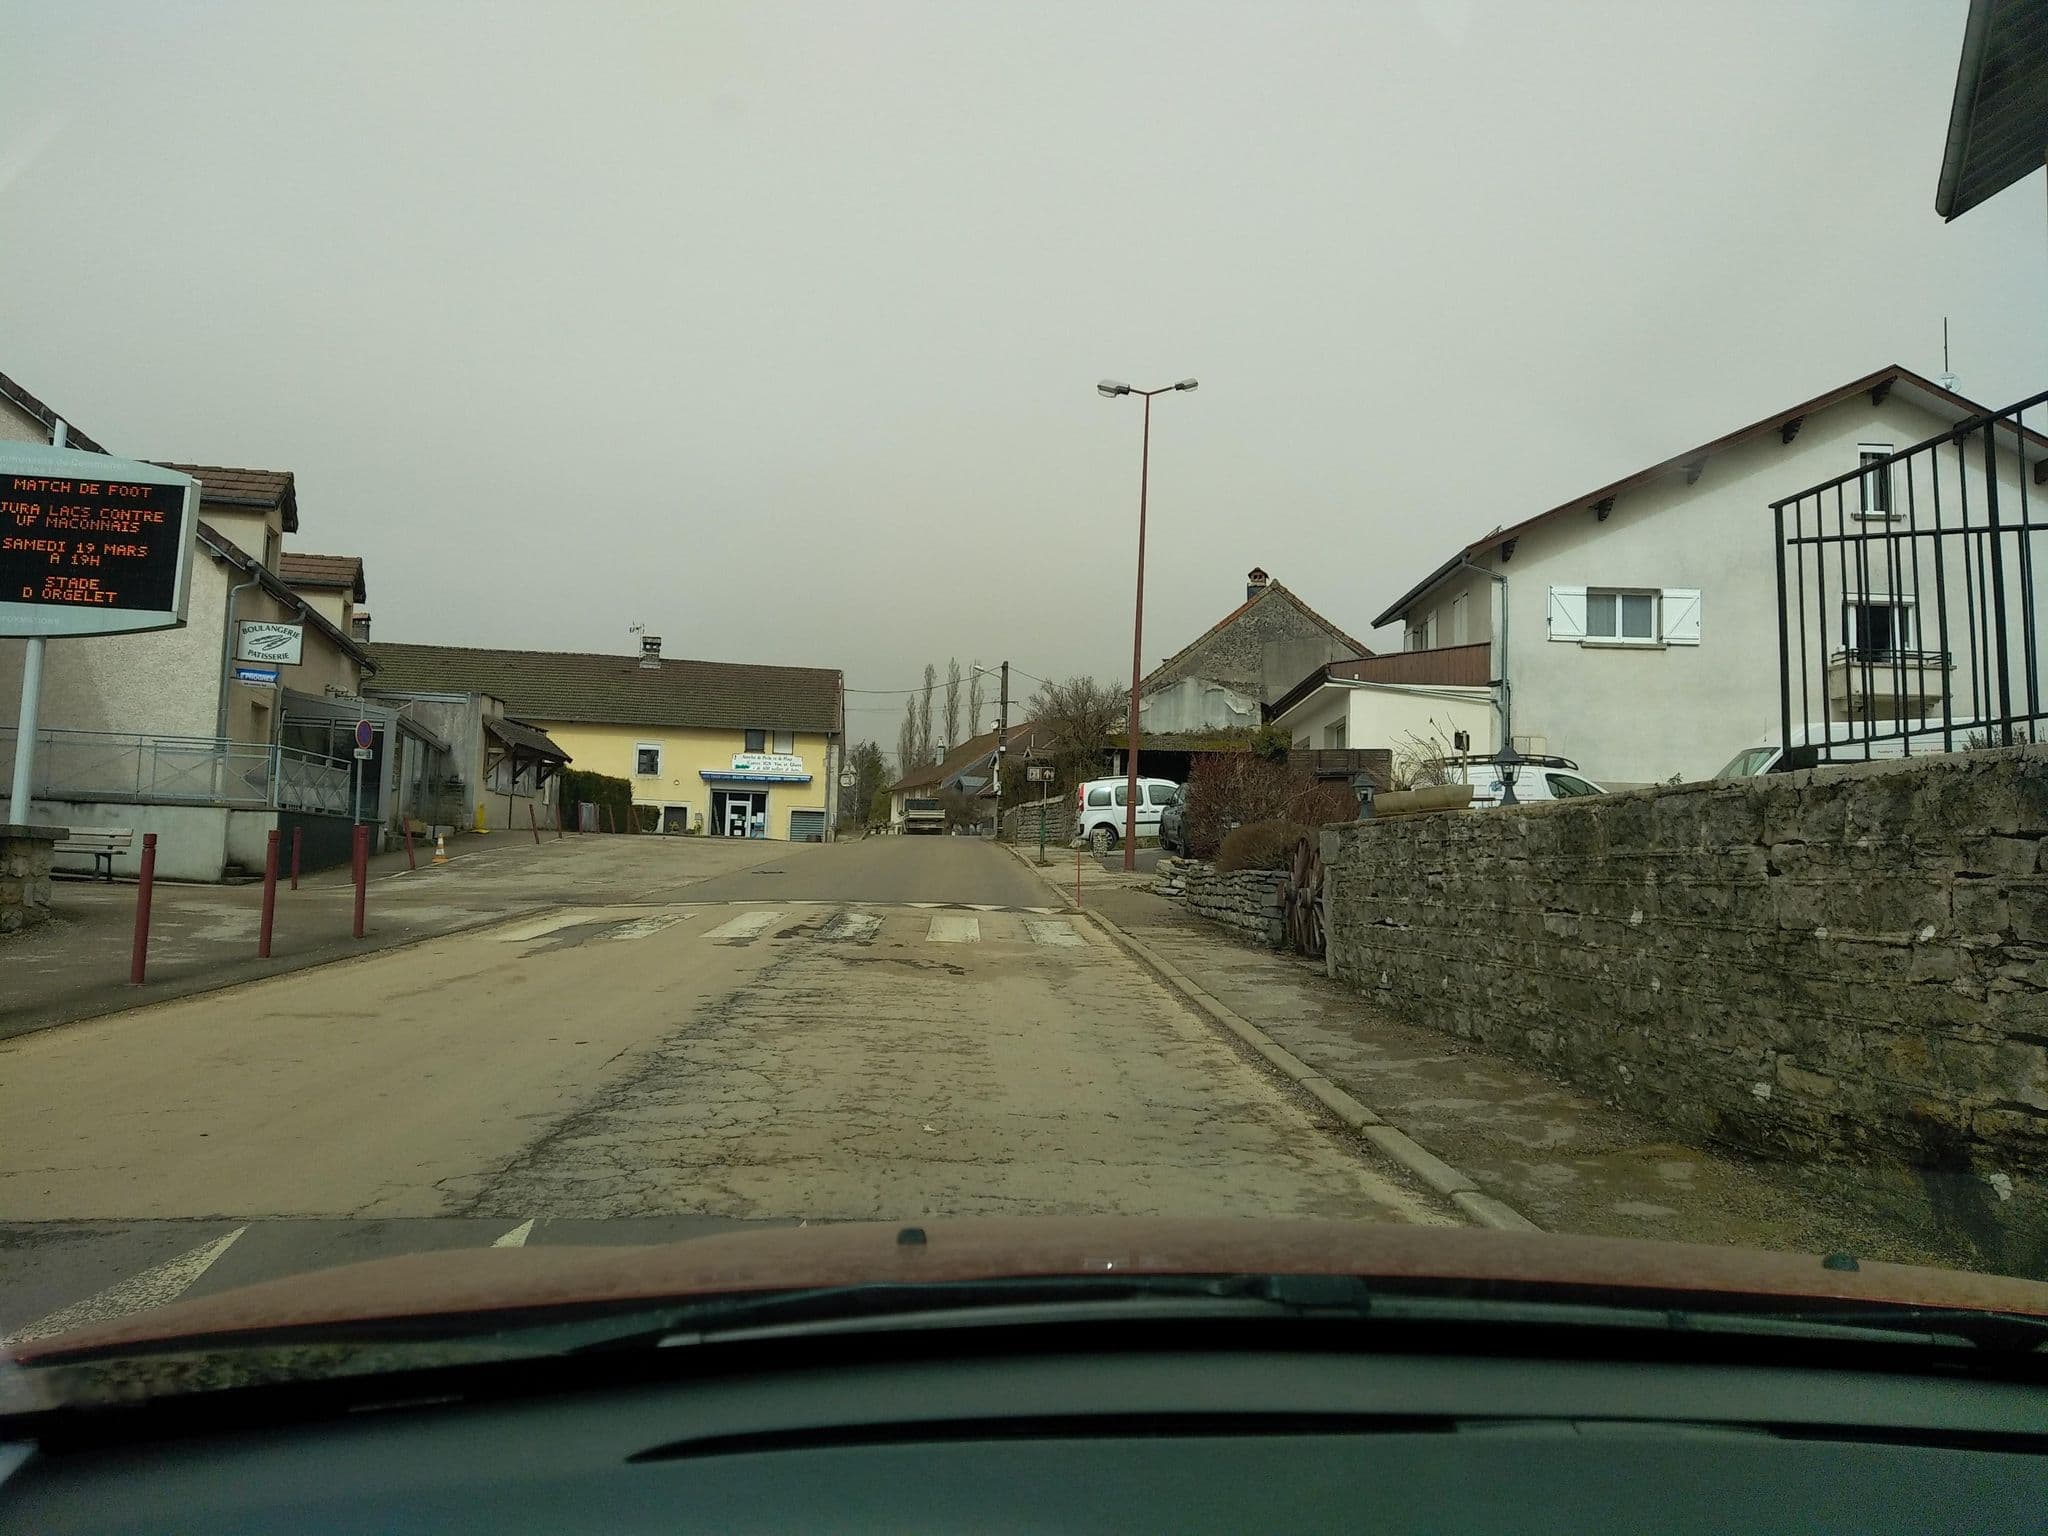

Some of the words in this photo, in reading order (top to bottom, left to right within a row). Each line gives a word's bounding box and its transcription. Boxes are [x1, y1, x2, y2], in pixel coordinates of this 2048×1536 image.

[14, 479, 71, 493] MATCH
[79, 483, 100, 495] DE
[108, 486, 152, 497] FOOT
[0, 501, 41, 515] JURA
[49, 505, 91, 518] LACS
[99, 510, 165, 523] CONTRE
[16, 515, 37, 526] UF
[46, 517, 141, 533] MACONNAIS
[2, 538, 66, 553] SAMEDI
[76, 543, 96, 553] 19
[103, 544, 149, 557] MARS
[50, 553, 60, 564] A
[70, 554, 100, 566] 19H
[45, 576, 100, 589] STADE
[22, 587, 33, 598] D
[42, 589, 118, 602] ORGELET
[241, 625, 300, 639] BOULANGERIE
[248, 650, 289, 660] PATISSERIE
